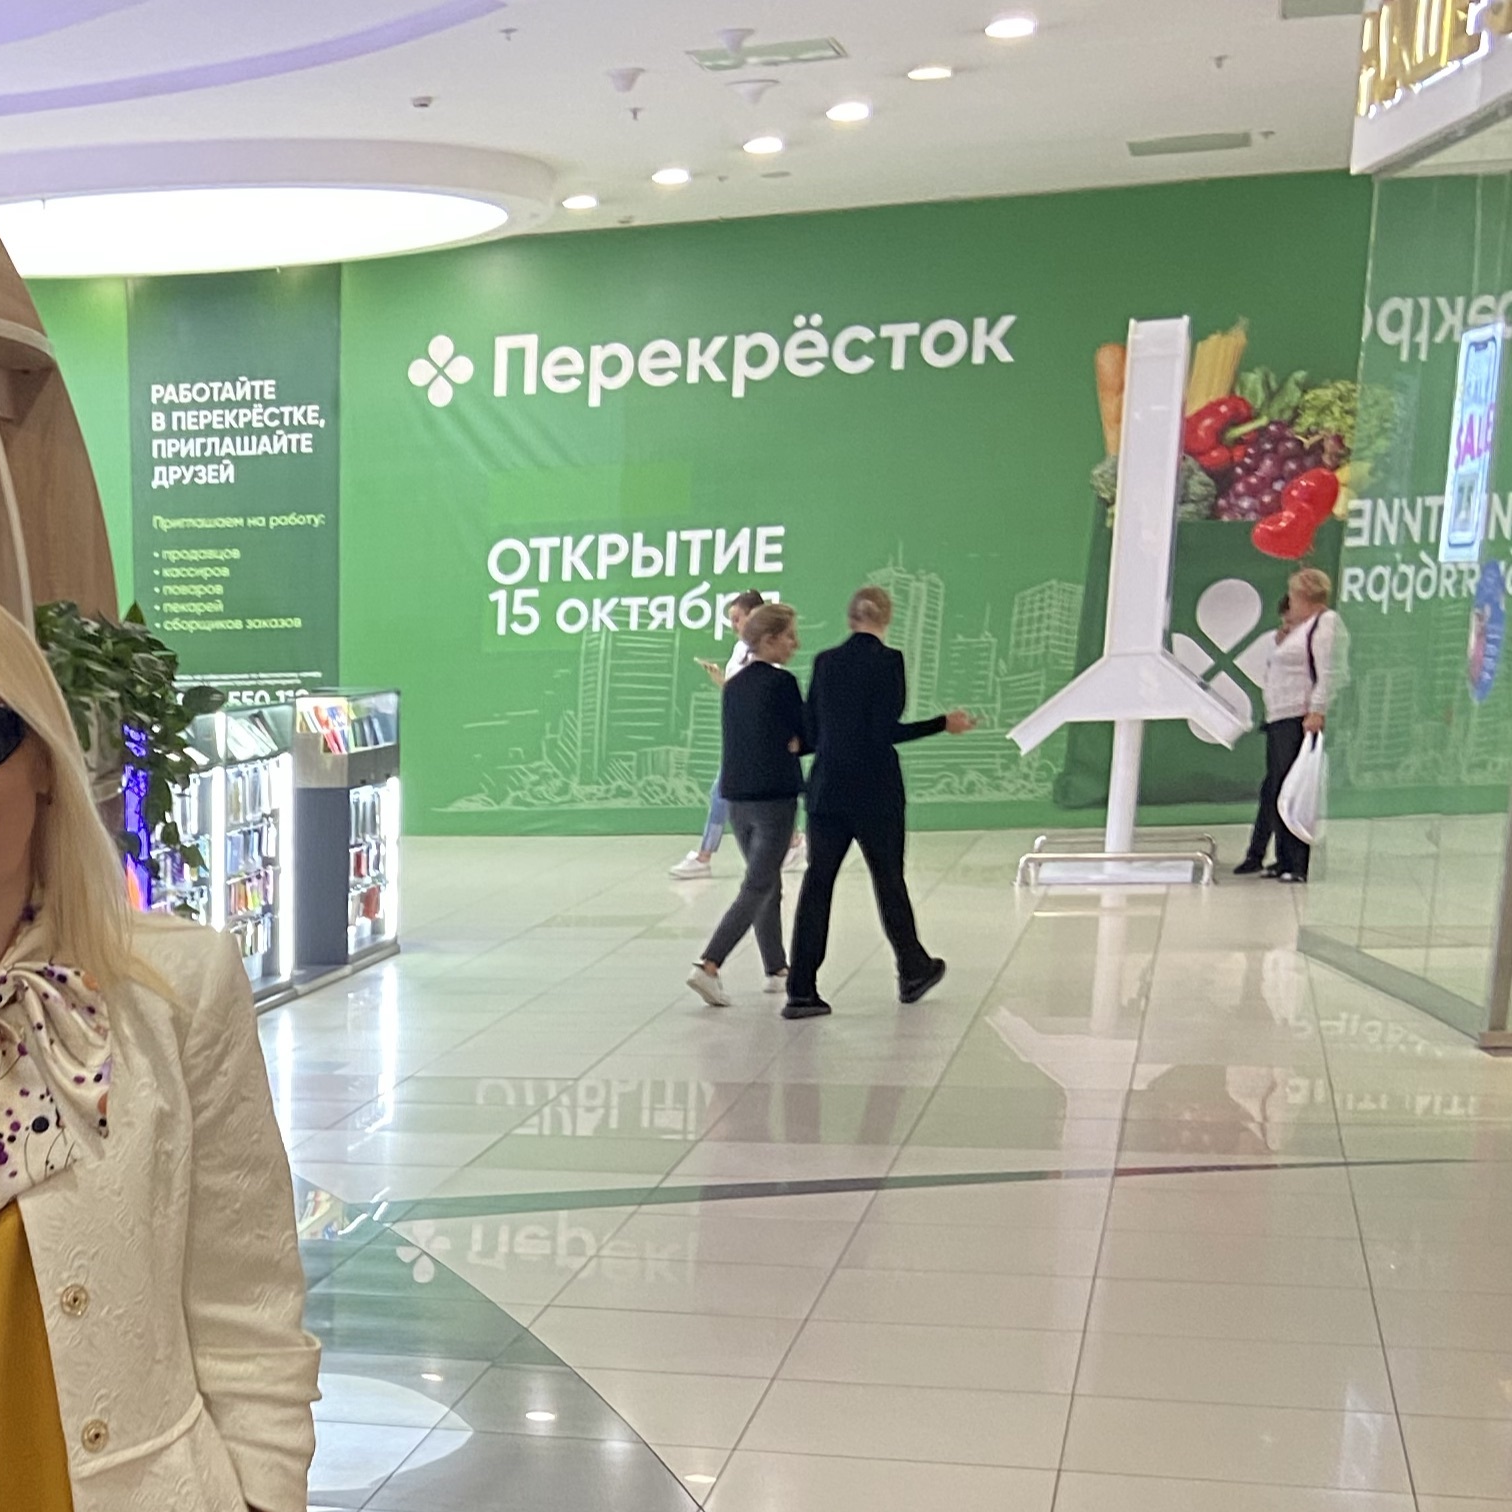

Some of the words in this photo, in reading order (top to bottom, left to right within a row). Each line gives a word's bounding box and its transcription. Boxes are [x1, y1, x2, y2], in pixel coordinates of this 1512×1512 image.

[493, 313, 1017, 407] Перекрёсток
[151, 376, 276, 404] РАБОТАЙТЕ
[151, 411, 166, 431] В
[171, 403, 325, 431] ПЕРЕКРЁСТКЕ,
[152, 429, 313, 458] ПРИГЛАШАЙТЕ
[151, 459, 235, 489] ДРУЗЕЙ
[152, 515, 244, 532] Приглашаем
[246, 516, 266, 527] на
[269, 512, 325, 529] работу:
[487, 525, 786, 585] ОТКРЫТИЕ
[245, 617, 302, 630] заказов
[488, 588, 540, 636] 15
[556, 581, 781, 640] октябр
